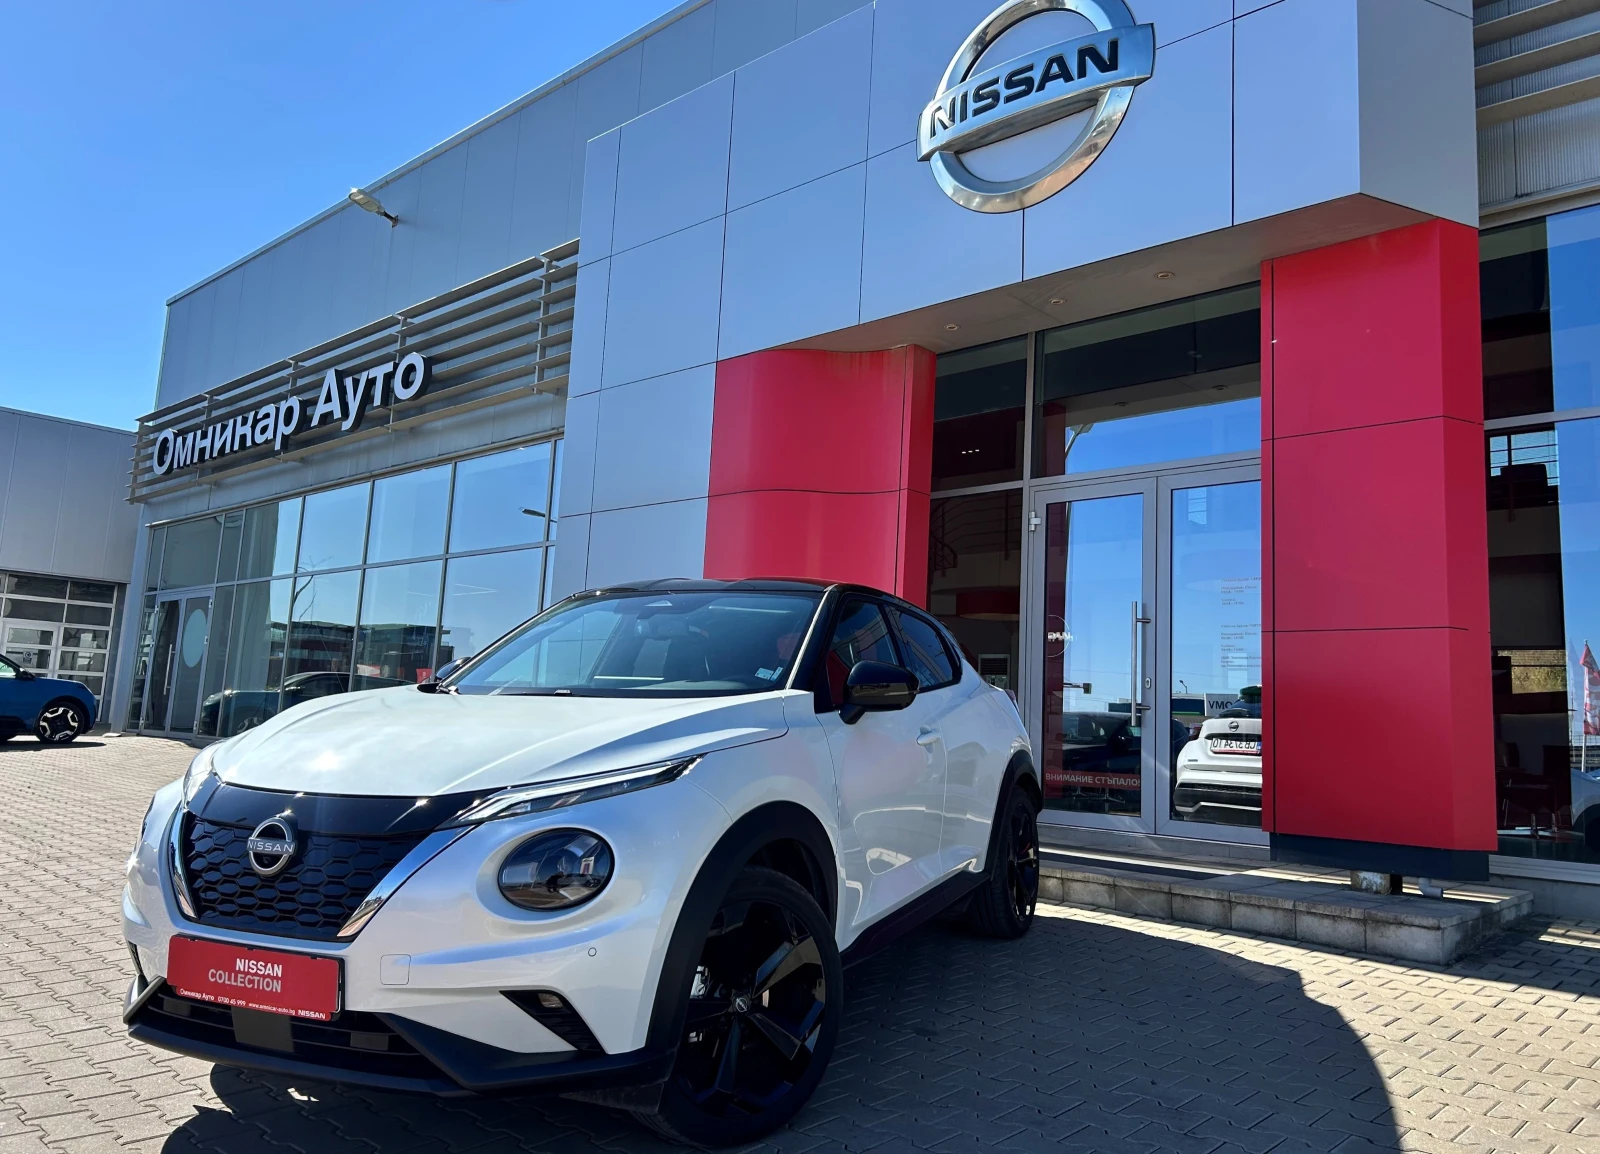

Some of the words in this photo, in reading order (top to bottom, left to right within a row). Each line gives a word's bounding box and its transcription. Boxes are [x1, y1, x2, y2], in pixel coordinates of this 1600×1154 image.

[930, 37, 1119, 139] NISSAN
[152, 395, 303, 476] Омникар
[311, 351, 427, 431] Ауто
[1045, 773, 1093, 783] ВНИМАНИЕ
[247, 841, 294, 852] NISSAN
[236, 958, 282, 977] NISSAN
[208, 969, 282, 992] COLLECTION
[180, 988, 202, 999] Омникар
[202, 993, 215, 1001] Ауто
[217, 996, 230, 1004] 0700
[248, 1002, 296, 1015] www.omnicar-auto.bg
[298, 1009, 326, 1019] NISSAN
